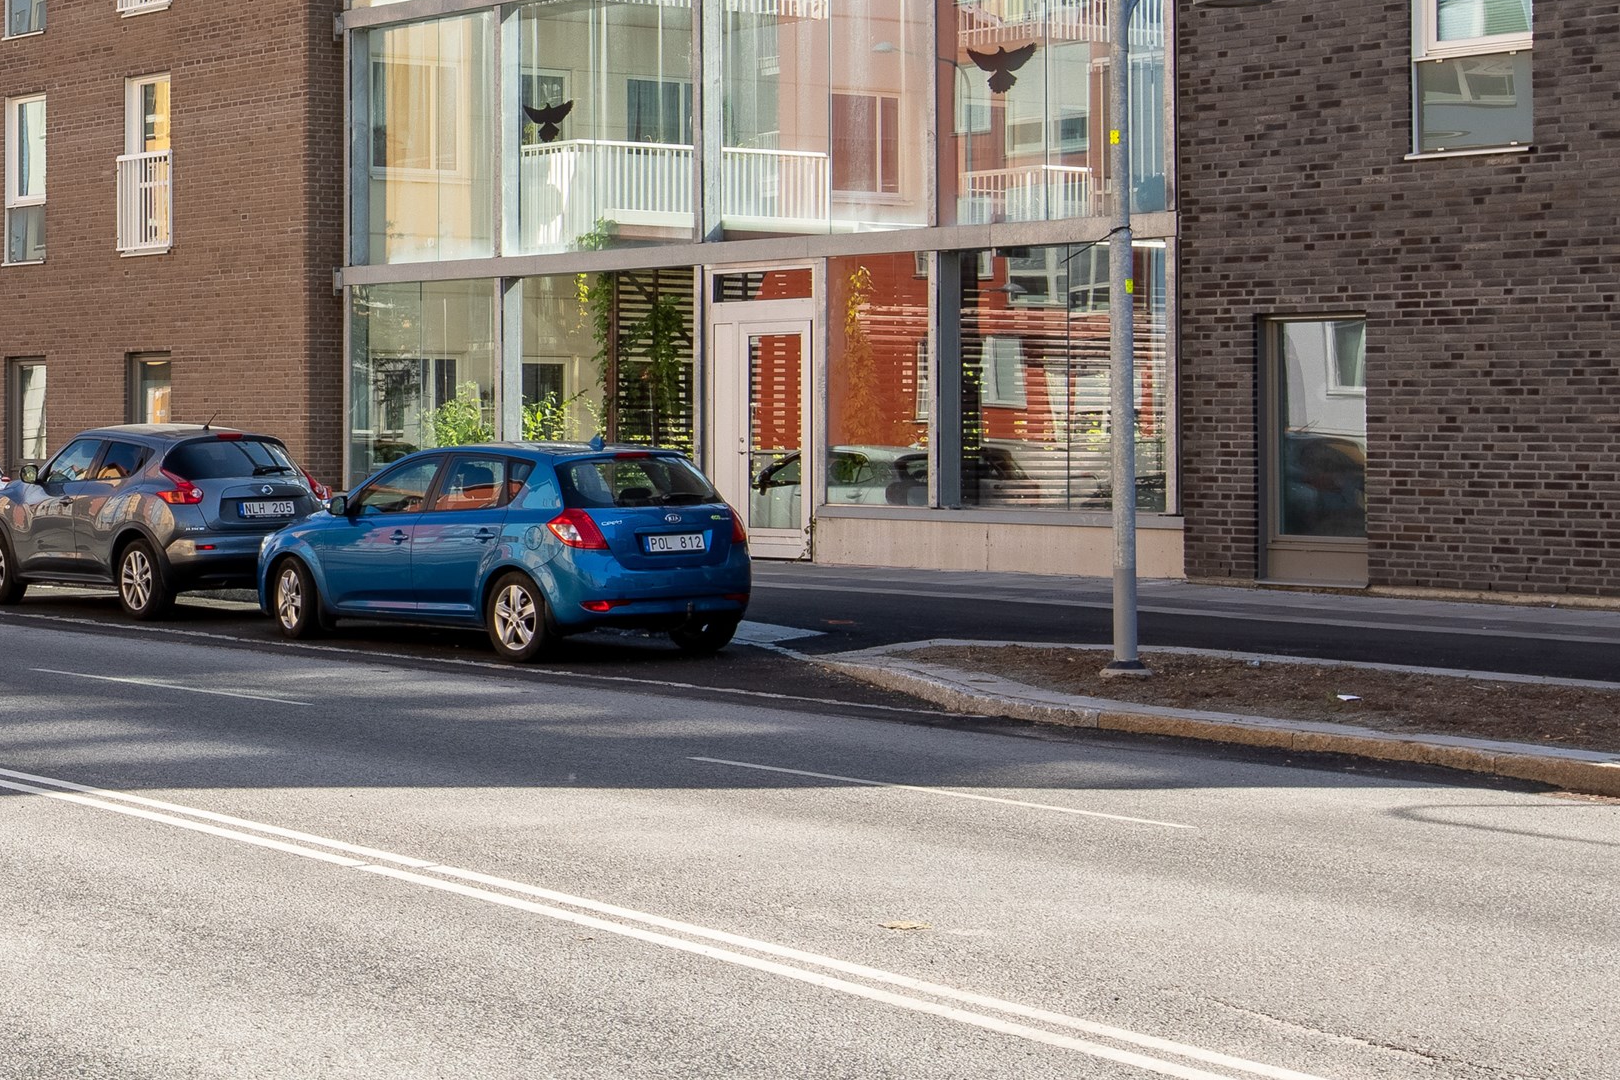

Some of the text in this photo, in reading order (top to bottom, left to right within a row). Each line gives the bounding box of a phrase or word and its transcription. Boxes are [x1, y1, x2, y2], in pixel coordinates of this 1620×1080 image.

[244, 502, 293, 515] NLH 205
[650, 535, 703, 551] POL 812
